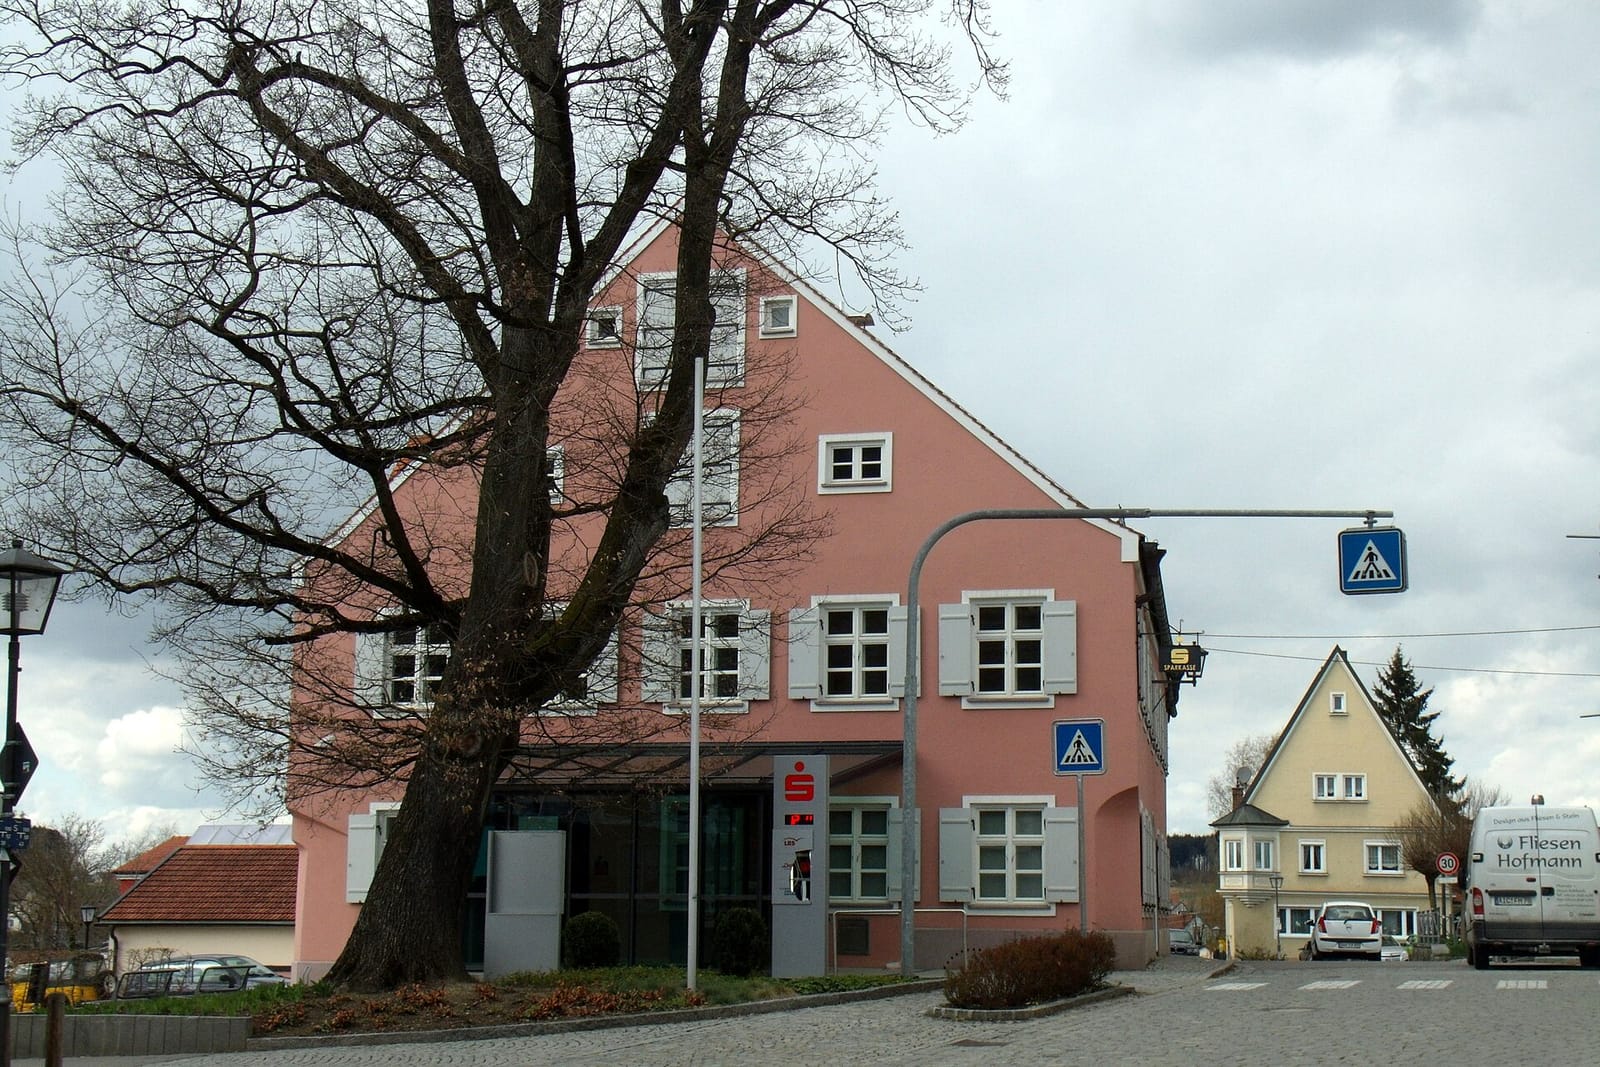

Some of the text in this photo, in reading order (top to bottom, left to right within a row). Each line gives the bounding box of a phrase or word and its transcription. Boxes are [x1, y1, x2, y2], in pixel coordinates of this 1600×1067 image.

[1493, 816, 1516, 825] Design
[1518, 835, 1581, 850] Fliesen
[1441, 858, 1454, 869] 30
[1497, 852, 1582, 870] Hofmann
